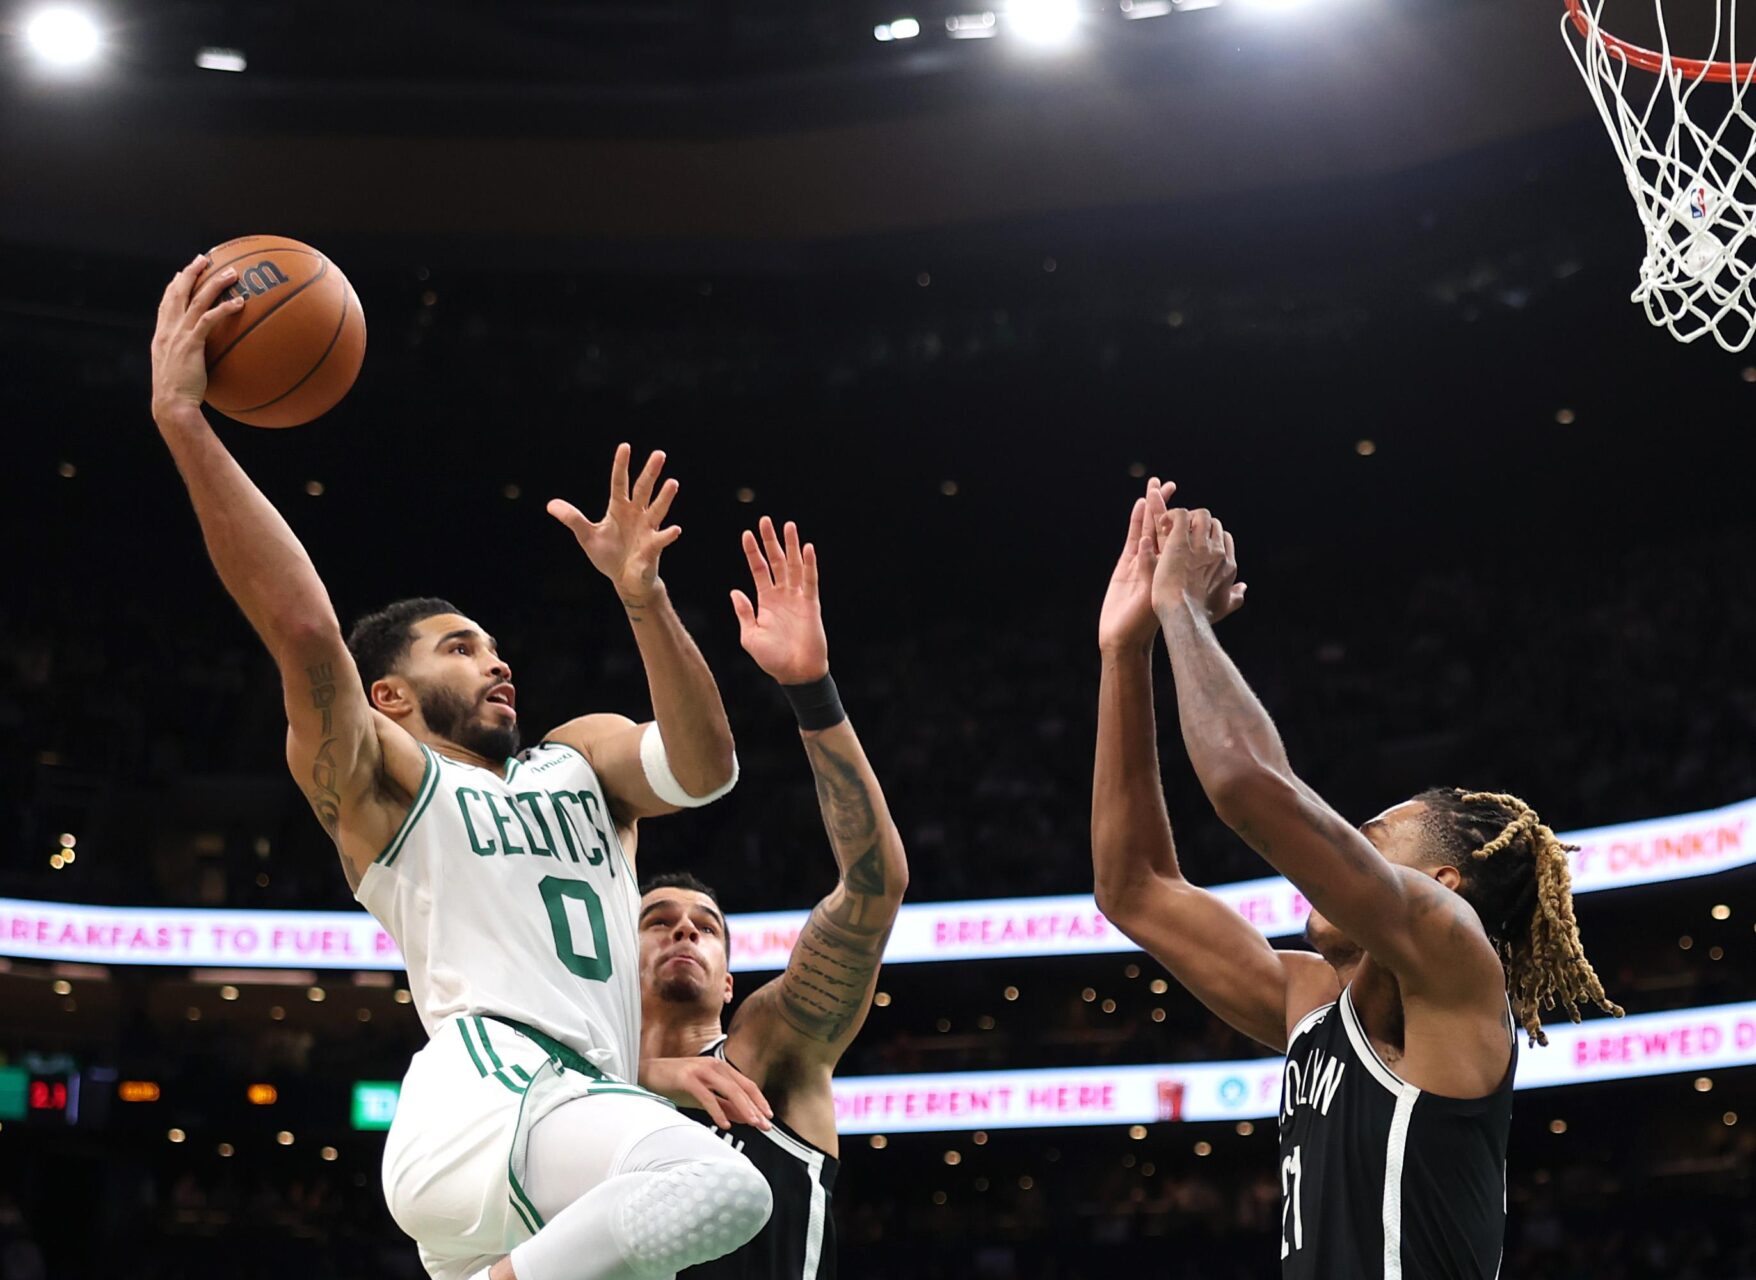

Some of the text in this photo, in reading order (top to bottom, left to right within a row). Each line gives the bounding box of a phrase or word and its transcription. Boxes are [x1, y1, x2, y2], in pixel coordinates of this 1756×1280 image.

[211, 927, 258, 953] TO
[271, 929, 357, 956] FUEL
[538, 875, 613, 983] 0
[934, 911, 1107, 945] BREAKFAS
[1575, 1025, 1722, 1068] BREWED
[1027, 1083, 1116, 1112] HERE
